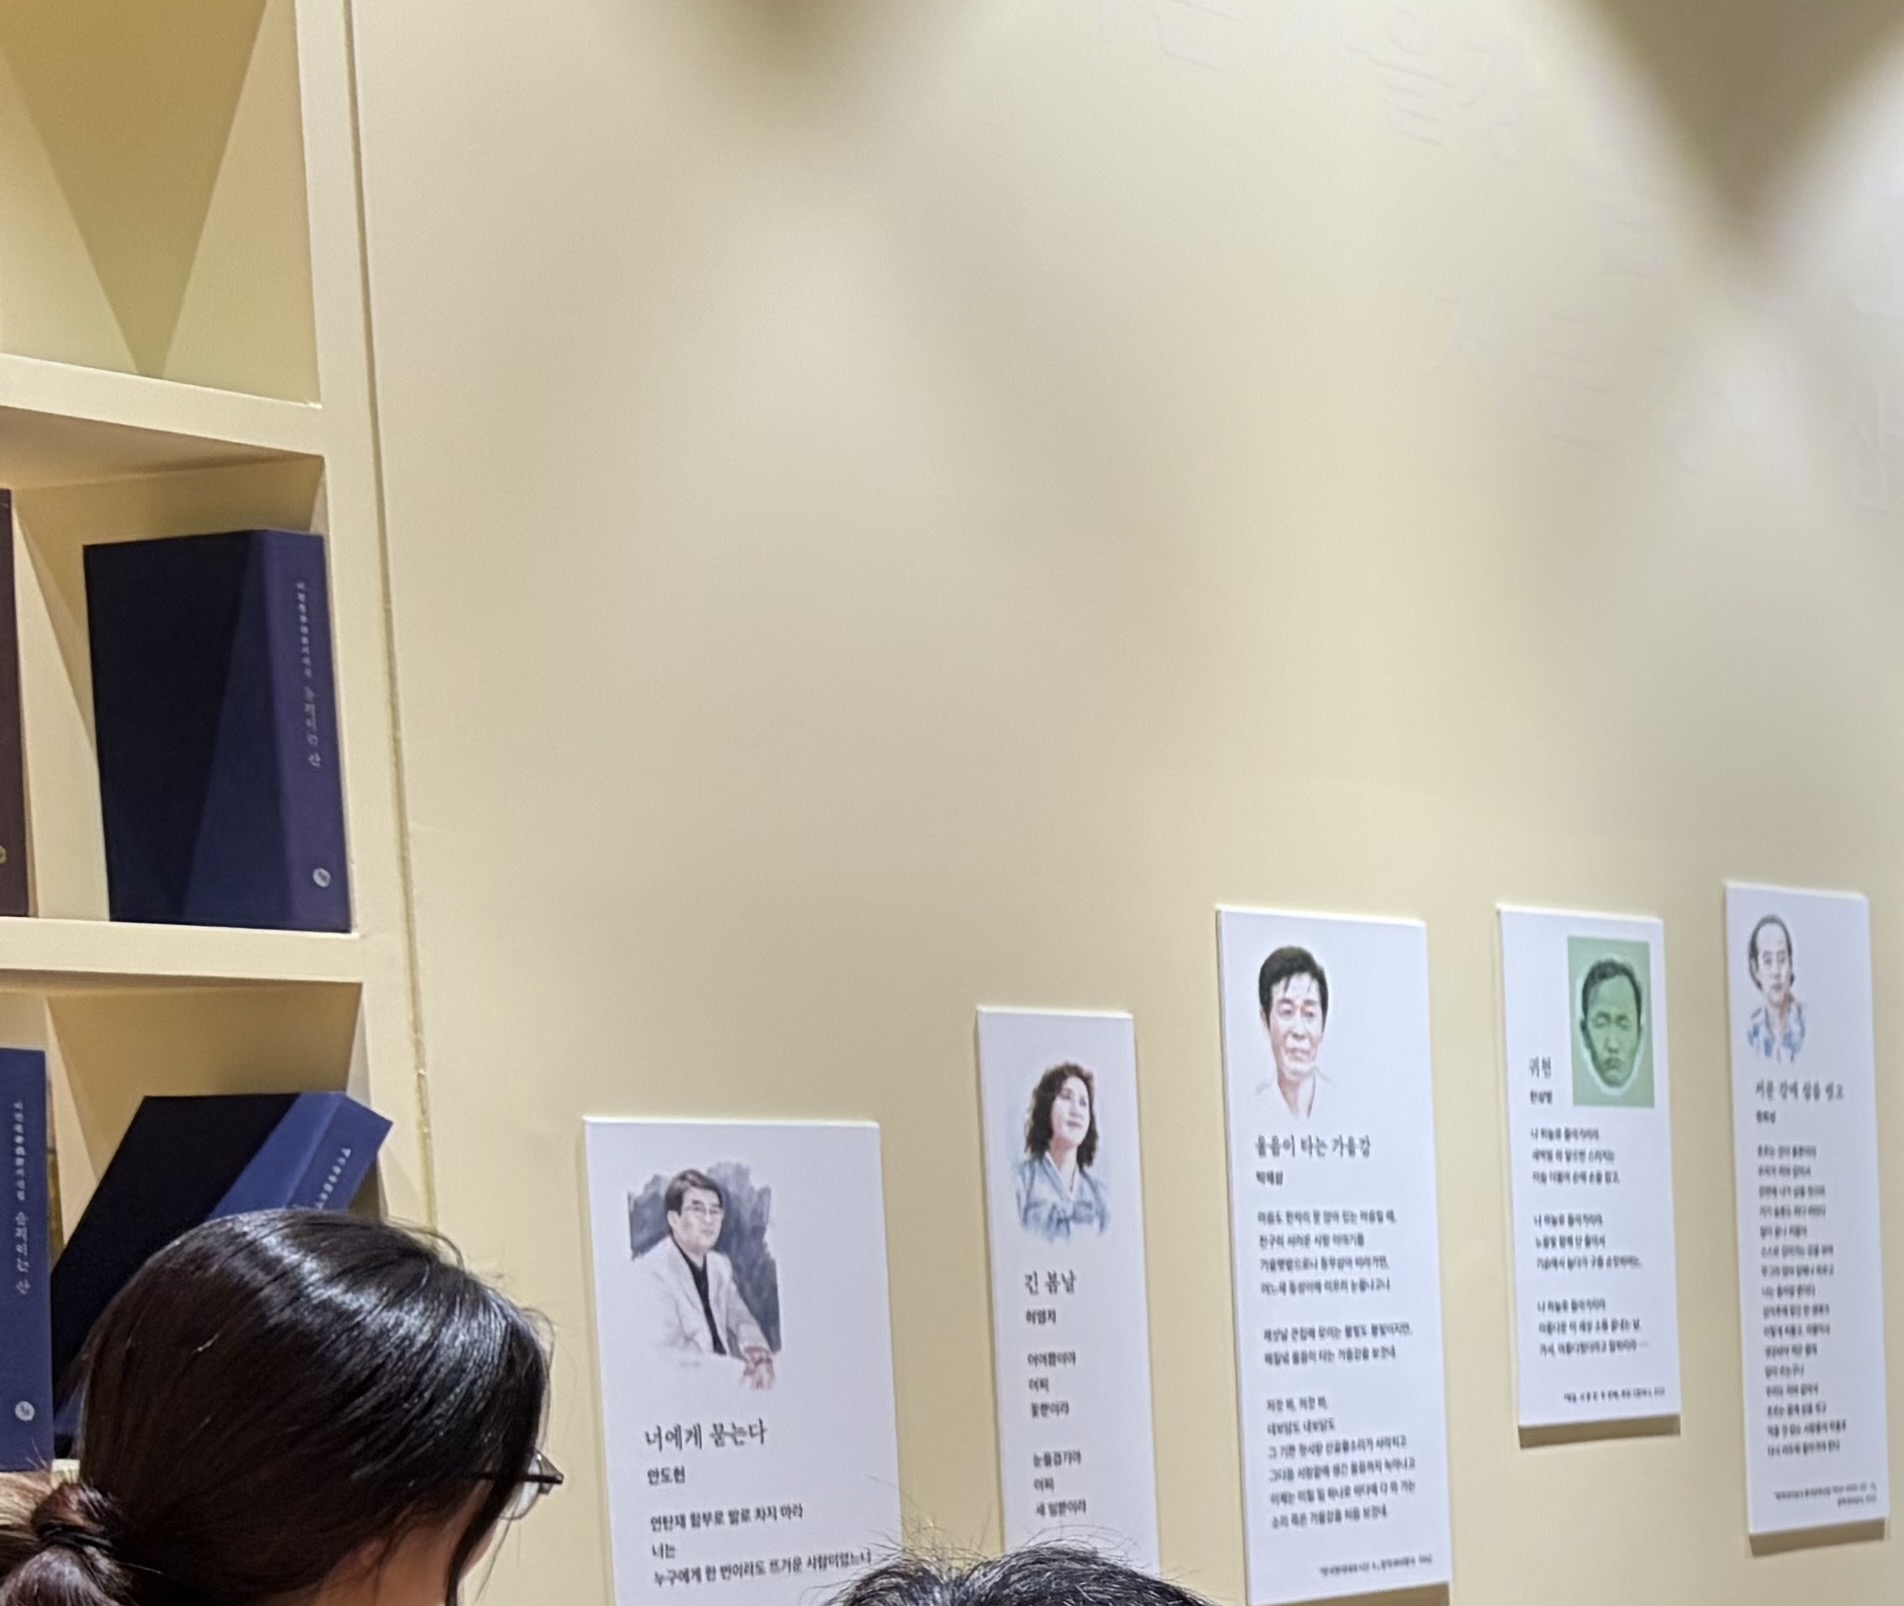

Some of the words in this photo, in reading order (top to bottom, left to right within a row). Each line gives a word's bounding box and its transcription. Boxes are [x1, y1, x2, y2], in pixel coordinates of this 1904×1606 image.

[1255, 1134, 1296, 1158] 울음이
[1300, 1134, 1328, 1158] 타는
[1332, 1134, 1371, 1158] 가을강
[1025, 1270, 1039, 1296] 긴
[1045, 1269, 1076, 1295] 봄날
[645, 1423, 703, 1452] 너에게
[710, 1418, 767, 1448] 묻는다
